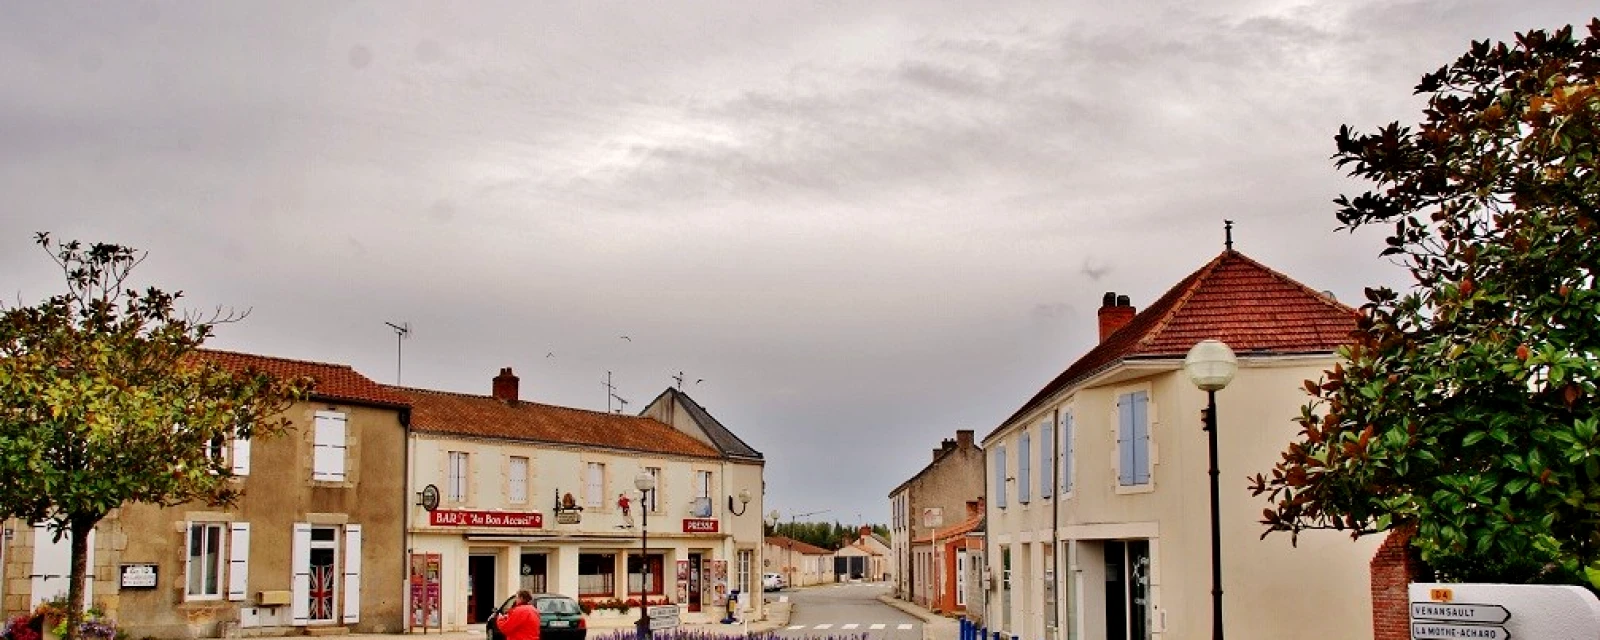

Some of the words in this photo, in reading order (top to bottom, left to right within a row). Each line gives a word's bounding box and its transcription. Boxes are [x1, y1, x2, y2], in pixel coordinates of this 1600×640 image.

[436, 512, 457, 523] BAR
[485, 514, 501, 525] Bon
[688, 520, 714, 530] PRESSE
[1415, 607, 1475, 617] VENANSAULT
[1415, 627, 1426, 635] LA
[1428, 628, 1496, 639] MOTHE-ACHARD
